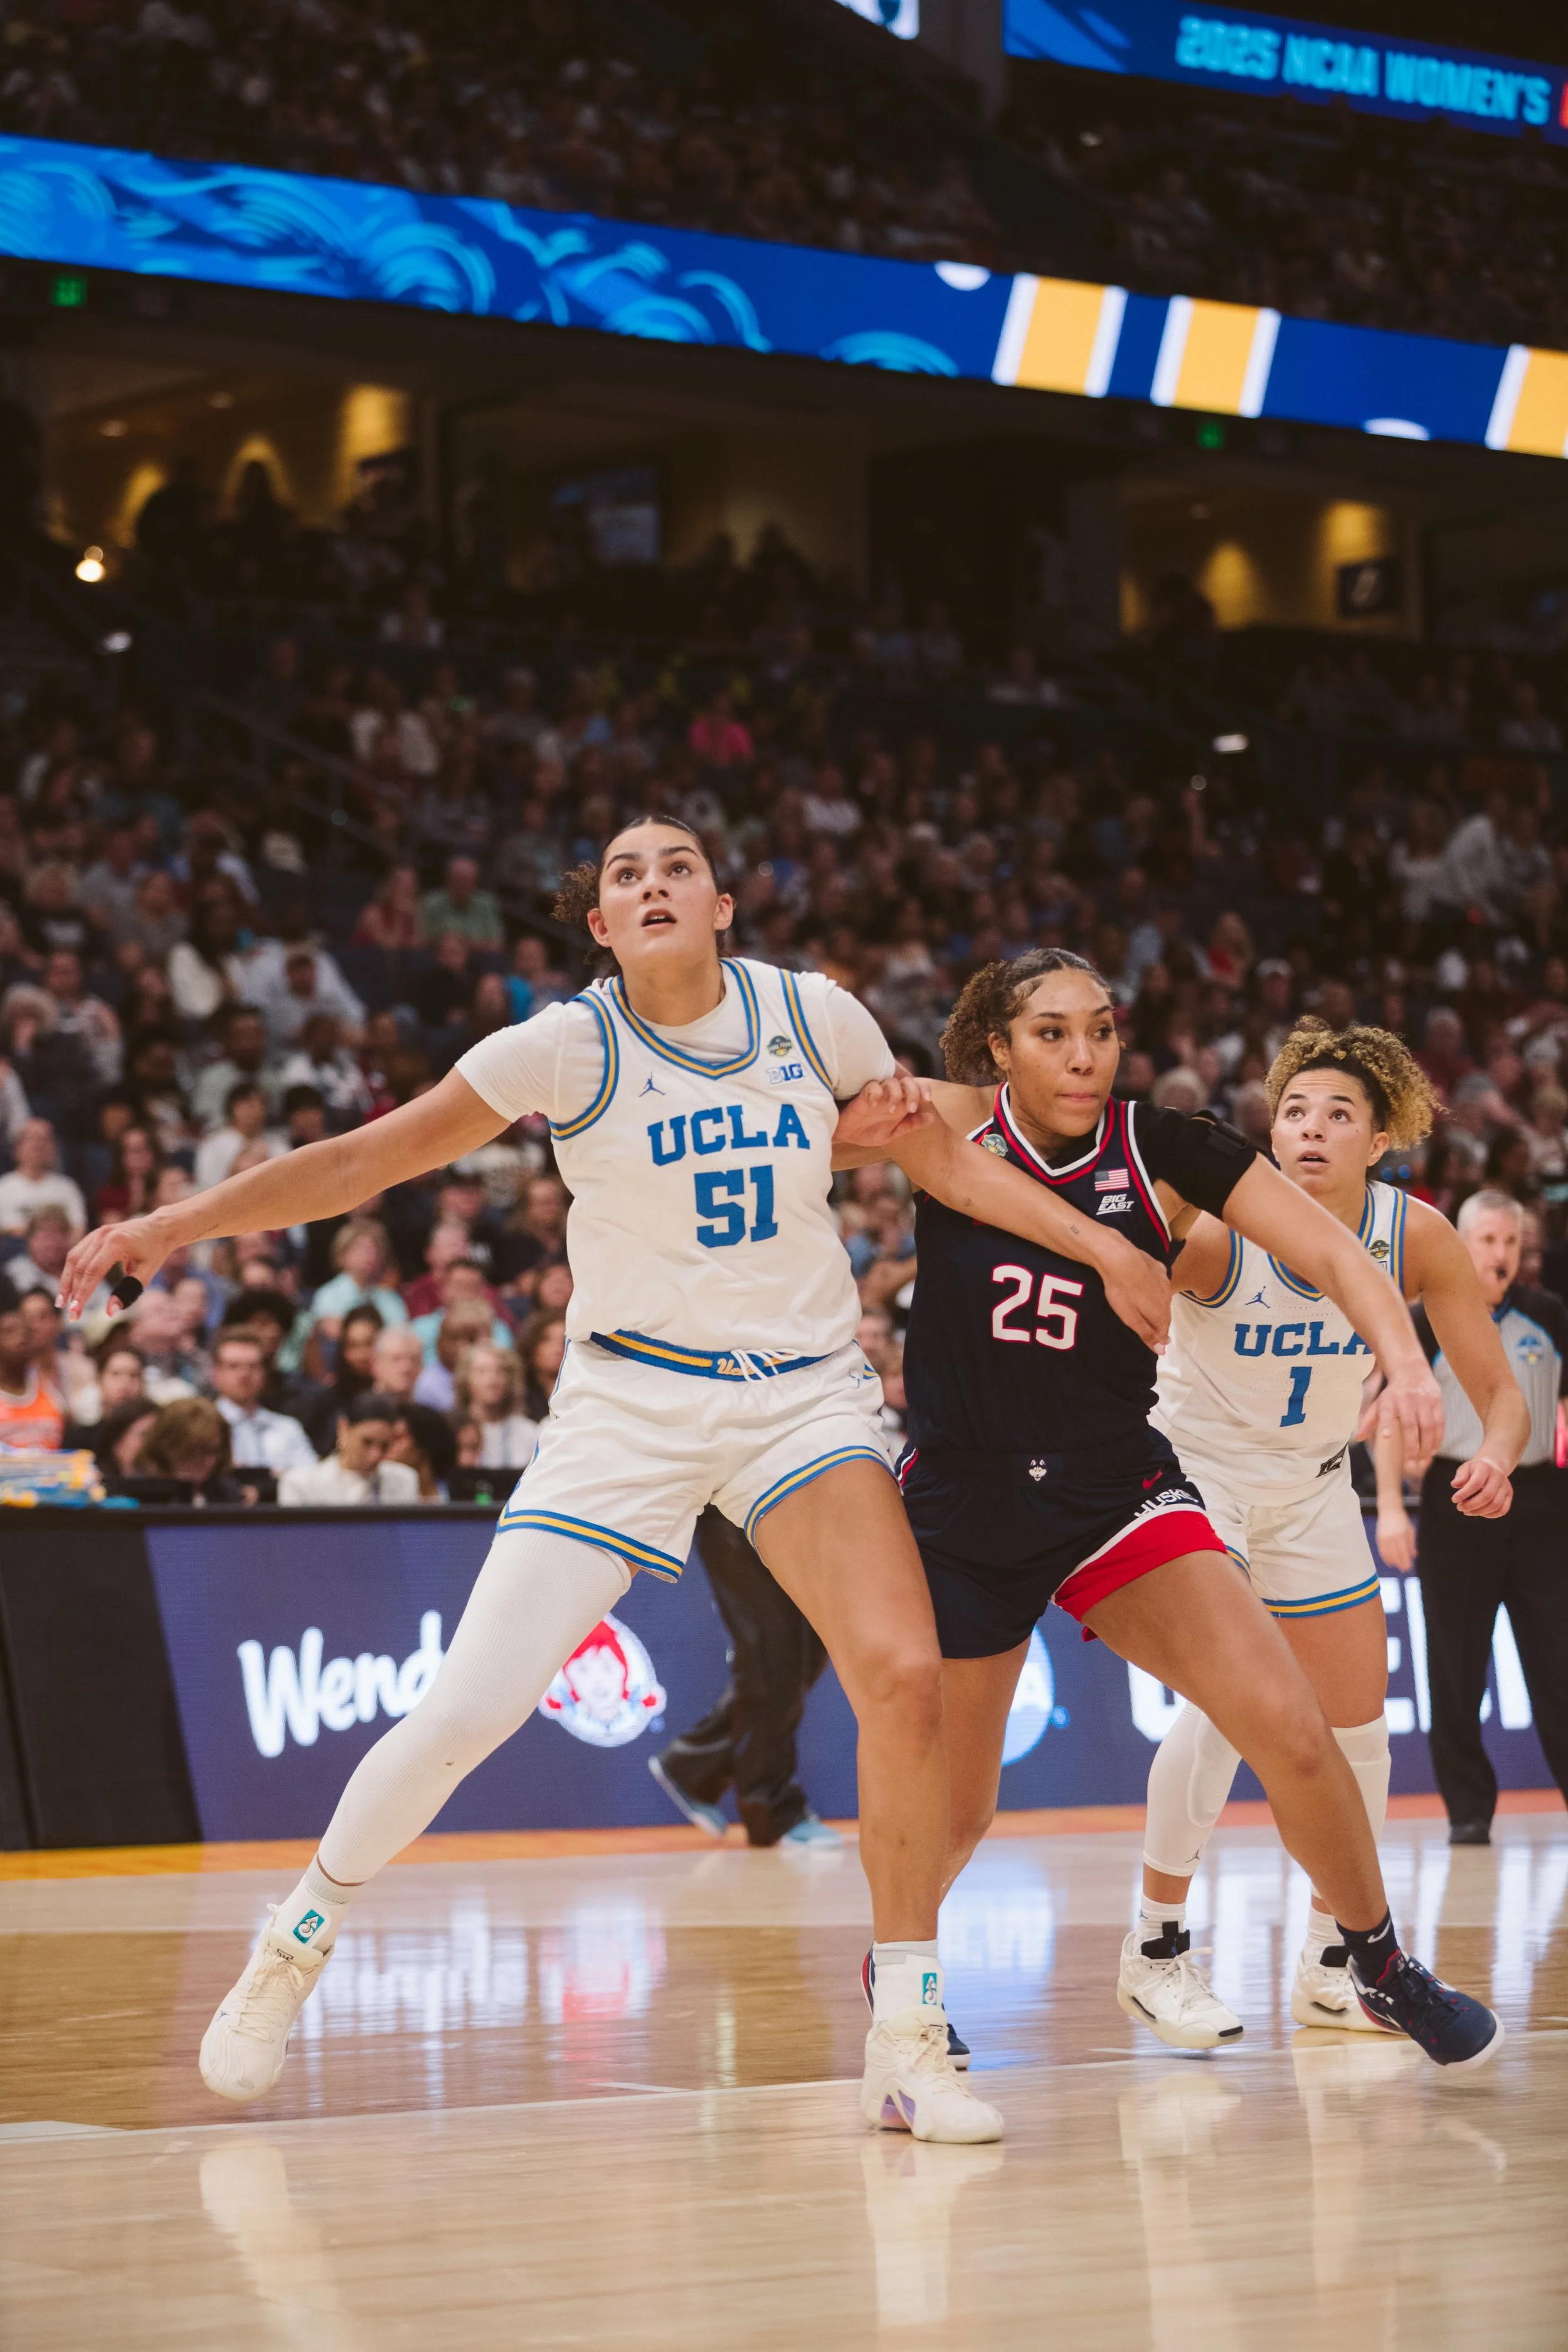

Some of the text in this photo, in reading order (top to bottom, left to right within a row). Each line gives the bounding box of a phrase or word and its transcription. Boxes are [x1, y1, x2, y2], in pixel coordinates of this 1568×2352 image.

[1175, 14, 1281, 80] 2025
[1282, 33, 1379, 97] NCAA
[1384, 50, 1552, 125] WOMEN'S
[647, 1103, 810, 1167] UCLA
[694, 1164, 778, 1248] 51
[1098, 1200, 1135, 1211] EAST
[1101, 1194, 1127, 1204] BIG
[990, 1263, 1086, 1352] 25
[1279, 1366, 1312, 1428] 1
